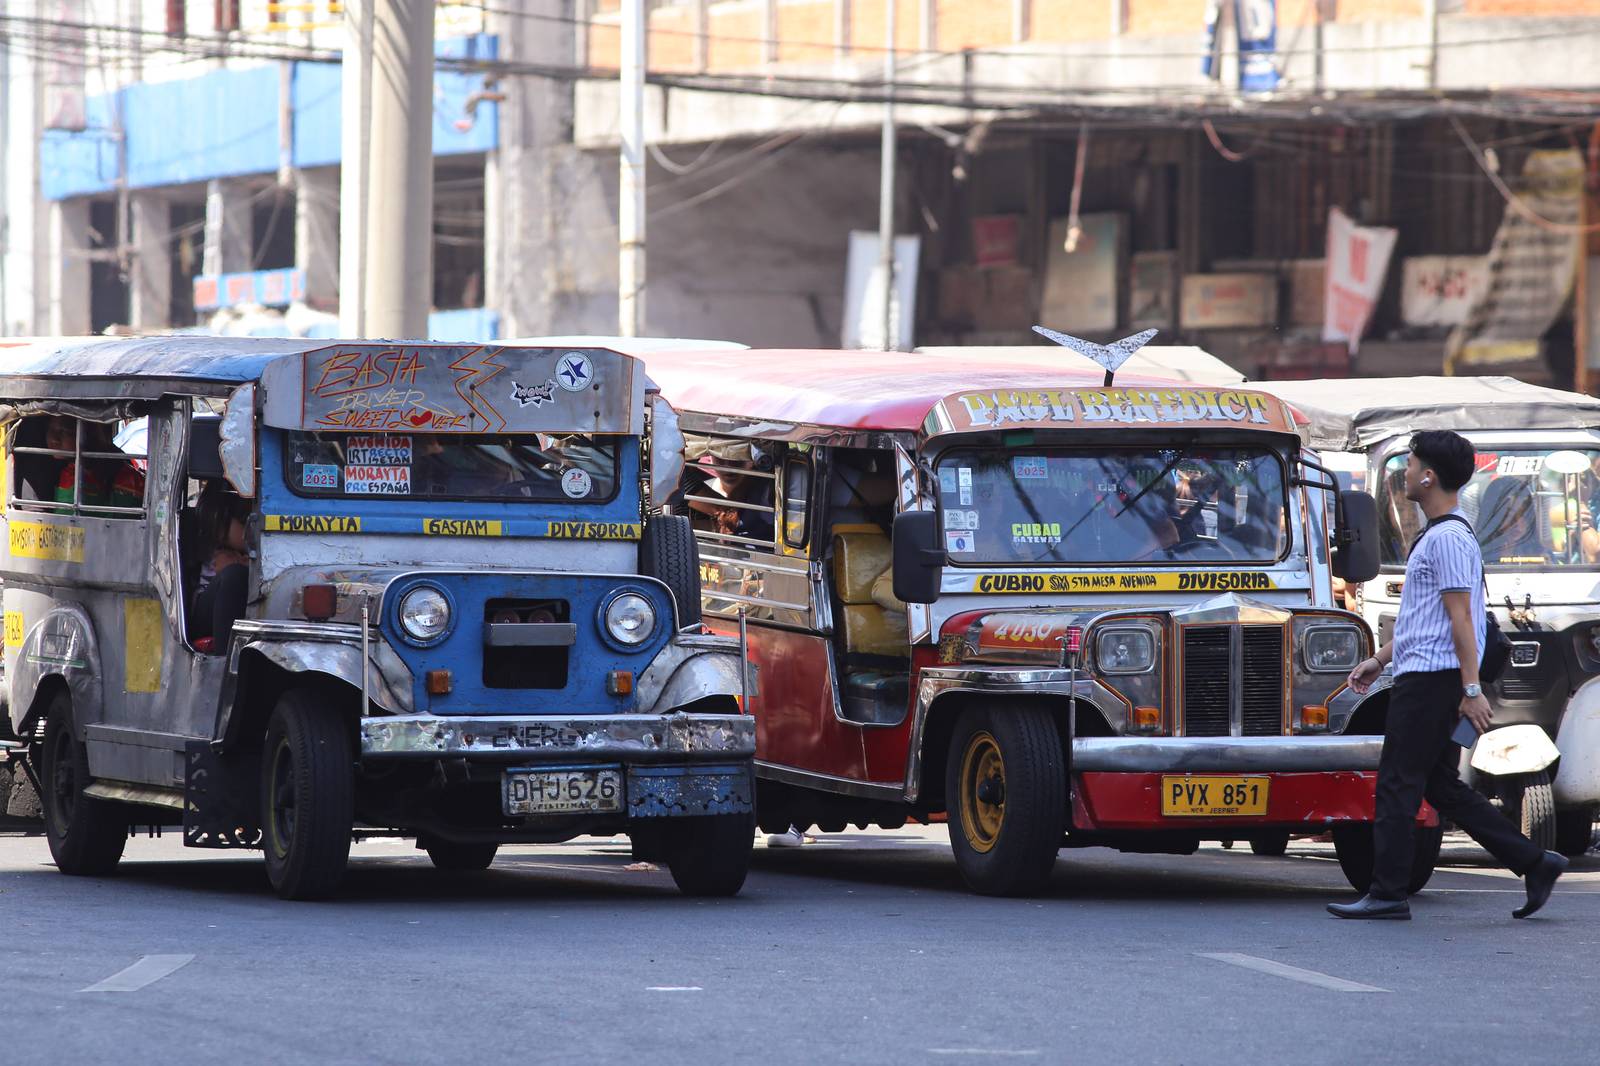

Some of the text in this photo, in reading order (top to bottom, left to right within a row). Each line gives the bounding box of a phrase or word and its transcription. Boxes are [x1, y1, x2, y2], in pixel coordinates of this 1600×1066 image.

[311, 349, 426, 398] BASTA
[1078, 389, 1270, 424] BENEDICT
[315, 407, 398, 429] SWEET
[348, 436, 412, 448] AVENIDA
[349, 447, 410, 464] LRT RECTO
[305, 474, 336, 485] 2025
[345, 466, 409, 481] MORAYTA
[1017, 466, 1046, 477] 2025
[345, 481, 410, 494] PRC ESPAÑA
[279, 515, 636, 538] MORAYTA GASTAM DIVISORIA
[1012, 523, 1061, 537] CUBAO
[979, 575, 1045, 591] CUBAO
[1071, 576, 1090, 589] STA
[1091, 575, 1116, 588] MESA
[1119, 575, 1157, 588] AVENIDA
[1178, 572, 1270, 590] DIVISORIA
[513, 776, 617, 801] DHJ 626
[1171, 783, 1259, 806] PVX 851
